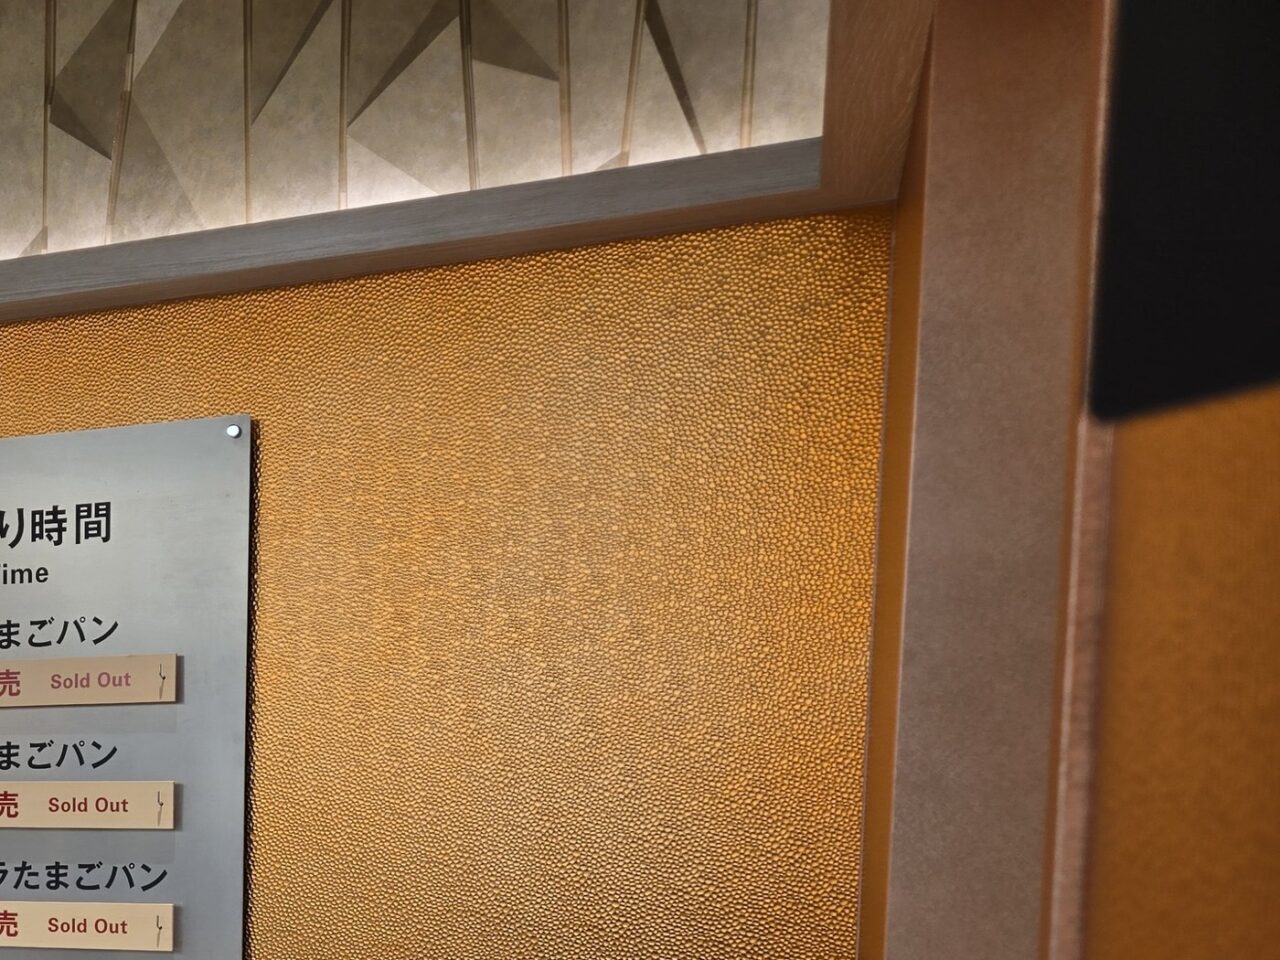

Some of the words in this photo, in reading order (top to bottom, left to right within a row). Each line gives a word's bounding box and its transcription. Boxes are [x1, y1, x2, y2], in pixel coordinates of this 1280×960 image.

[50, 671, 91, 690] Sold
[97, 670, 132, 689] Out
[47, 796, 89, 814] Sold
[94, 797, 129, 814] Out
[47, 917, 88, 934] Sold
[93, 917, 128, 936] Out
